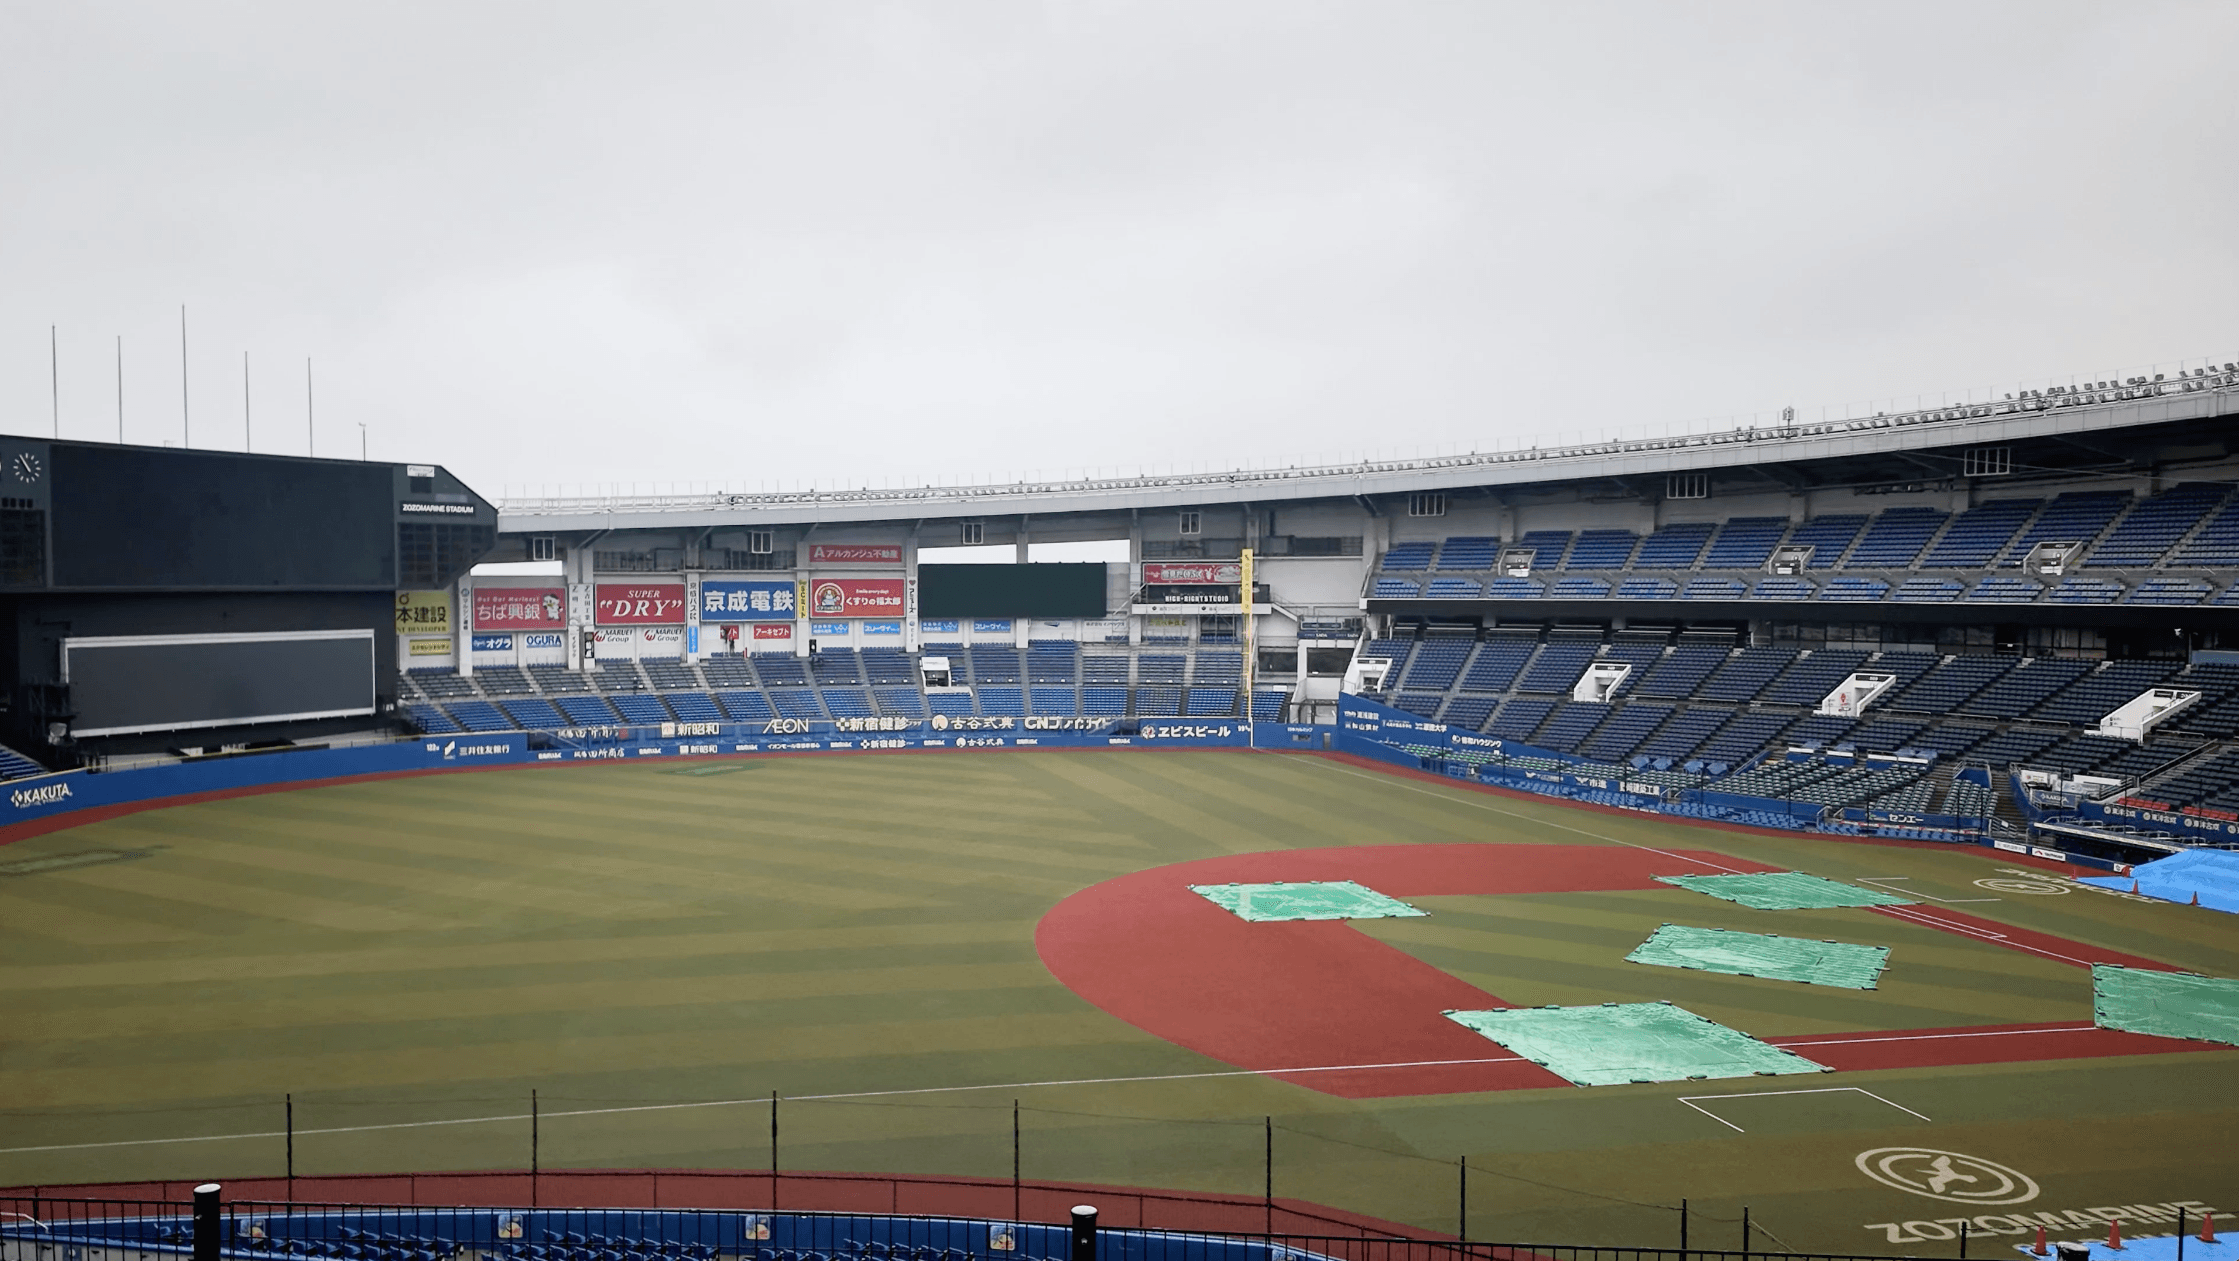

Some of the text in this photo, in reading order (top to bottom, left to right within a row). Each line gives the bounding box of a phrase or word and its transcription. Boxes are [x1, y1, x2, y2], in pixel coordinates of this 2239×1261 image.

[402, 503, 474, 514] ZOZOMARINE STADIUM
[627, 590, 660, 598] SUPER
[705, 590, 794, 612] 京成電鉄
[845, 597, 901, 605] くすりの福太郎
[477, 603, 540, 620] ちば興銀
[486, 638, 512, 649] オグラ
[526, 635, 562, 646] OGURA
[951, 716, 1014, 729] 古谷式典
[677, 722, 719, 736] 新昭和
[967, 738, 1004, 747] 古谷式典
[459, 744, 510, 756] 三井住友銀行
[690, 745, 717, 753] 新昭和
[24, 782, 69, 803] KAKUTA
[1889, 814, 1924, 823] センエー
